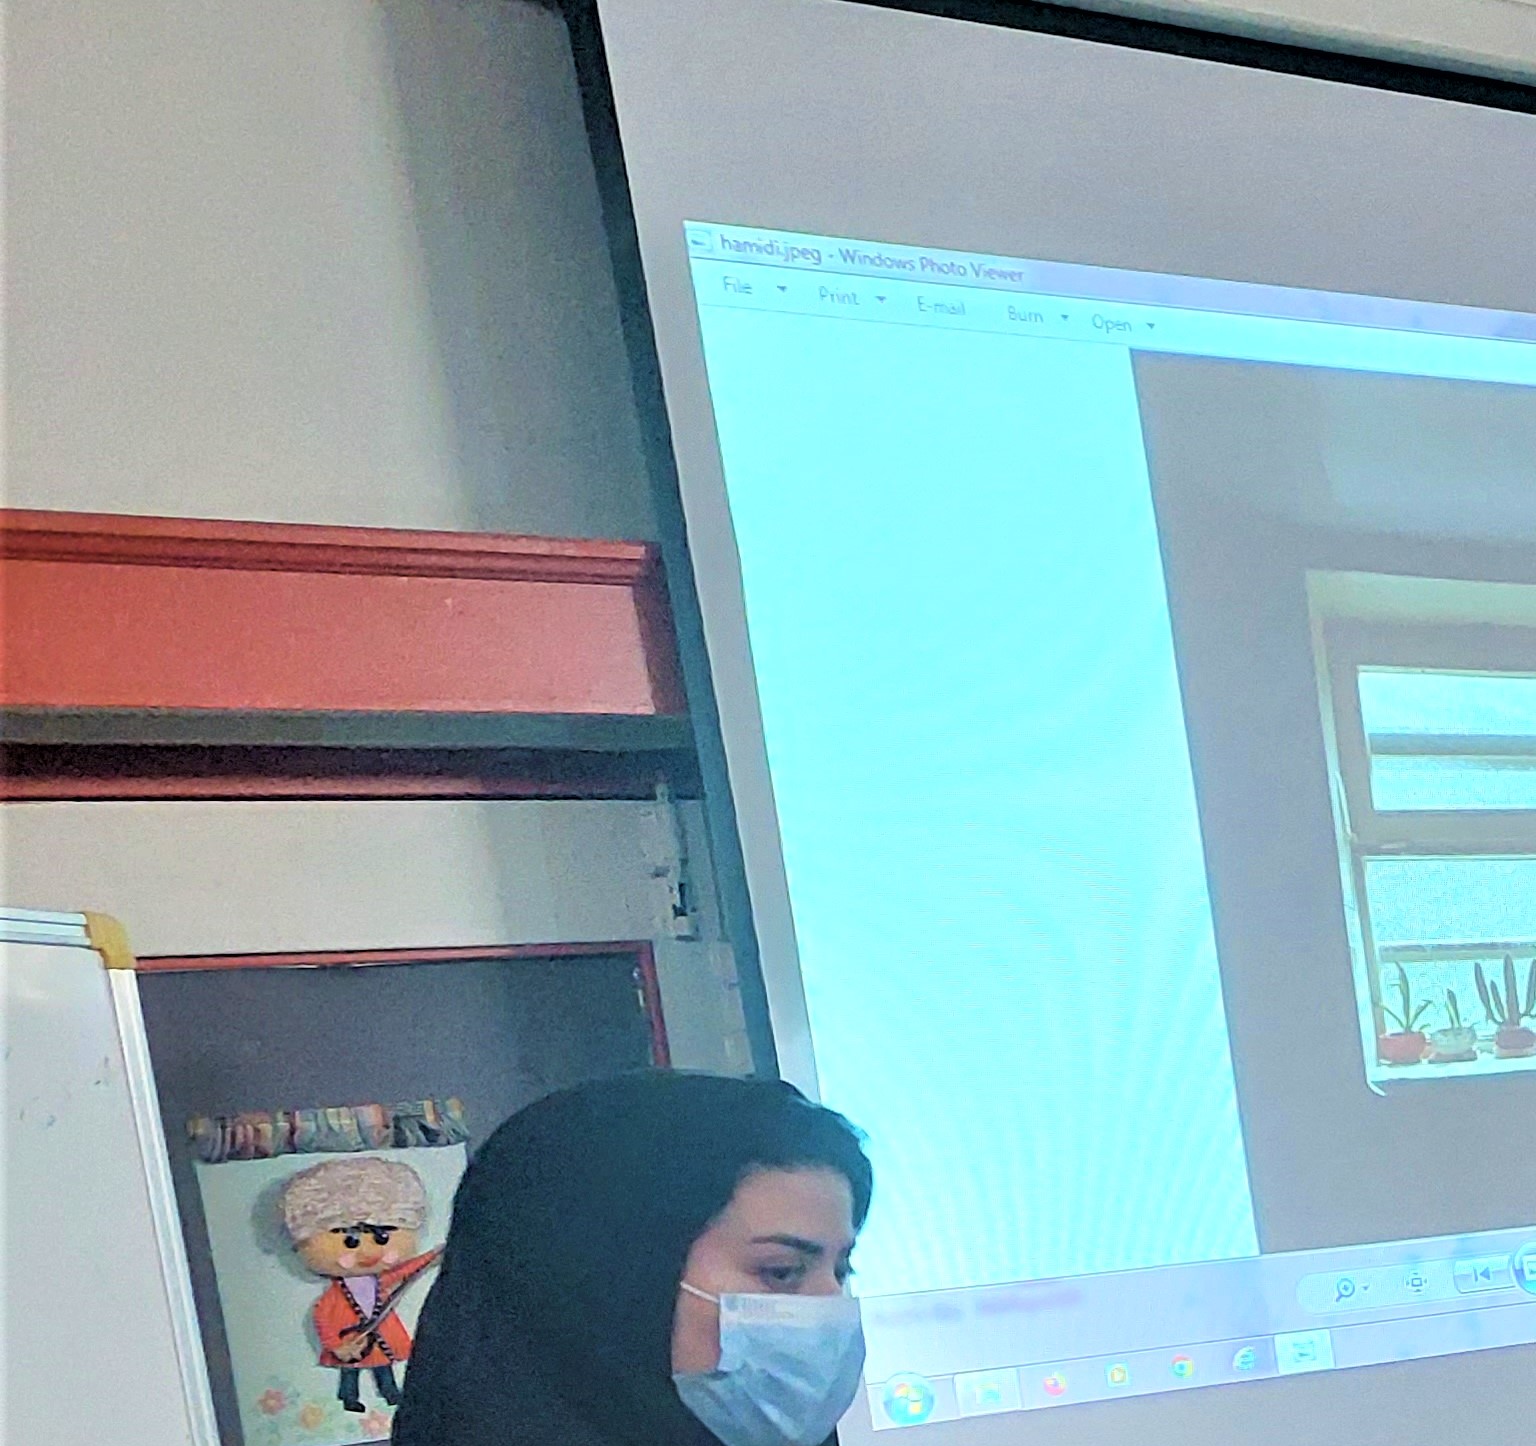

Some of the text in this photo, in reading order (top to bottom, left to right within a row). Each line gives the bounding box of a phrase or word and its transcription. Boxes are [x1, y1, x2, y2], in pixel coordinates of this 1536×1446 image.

[838, 247, 916, 271] Windows
[919, 256, 967, 277] Photo
[969, 261, 1025, 283] Viewer
[722, 275, 753, 295] File
[818, 285, 861, 306] Print
[916, 295, 966, 316] E-mail
[1007, 305, 1044, 324] Burn
[1091, 313, 1133, 334] Open
